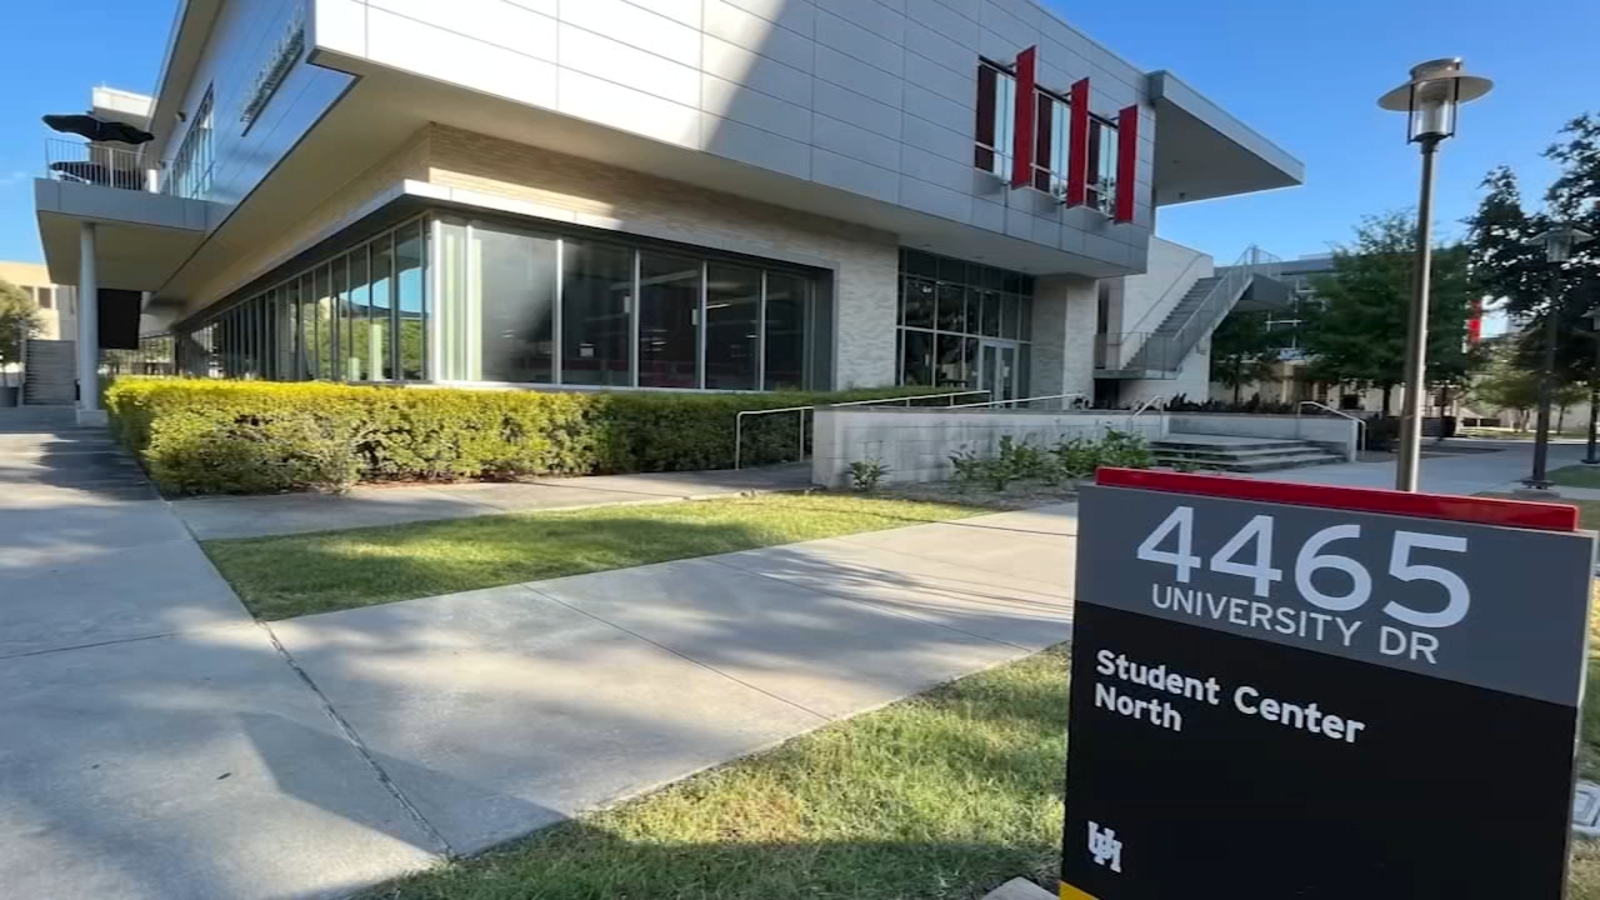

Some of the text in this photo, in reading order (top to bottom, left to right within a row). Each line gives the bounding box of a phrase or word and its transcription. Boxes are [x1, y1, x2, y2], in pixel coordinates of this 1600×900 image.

[1137, 506, 1470, 628] 4465
[1152, 583, 1439, 664] UNIVERSITY DR
[1094, 683, 1182, 732] North
[1096, 649, 1366, 743] Student Center
